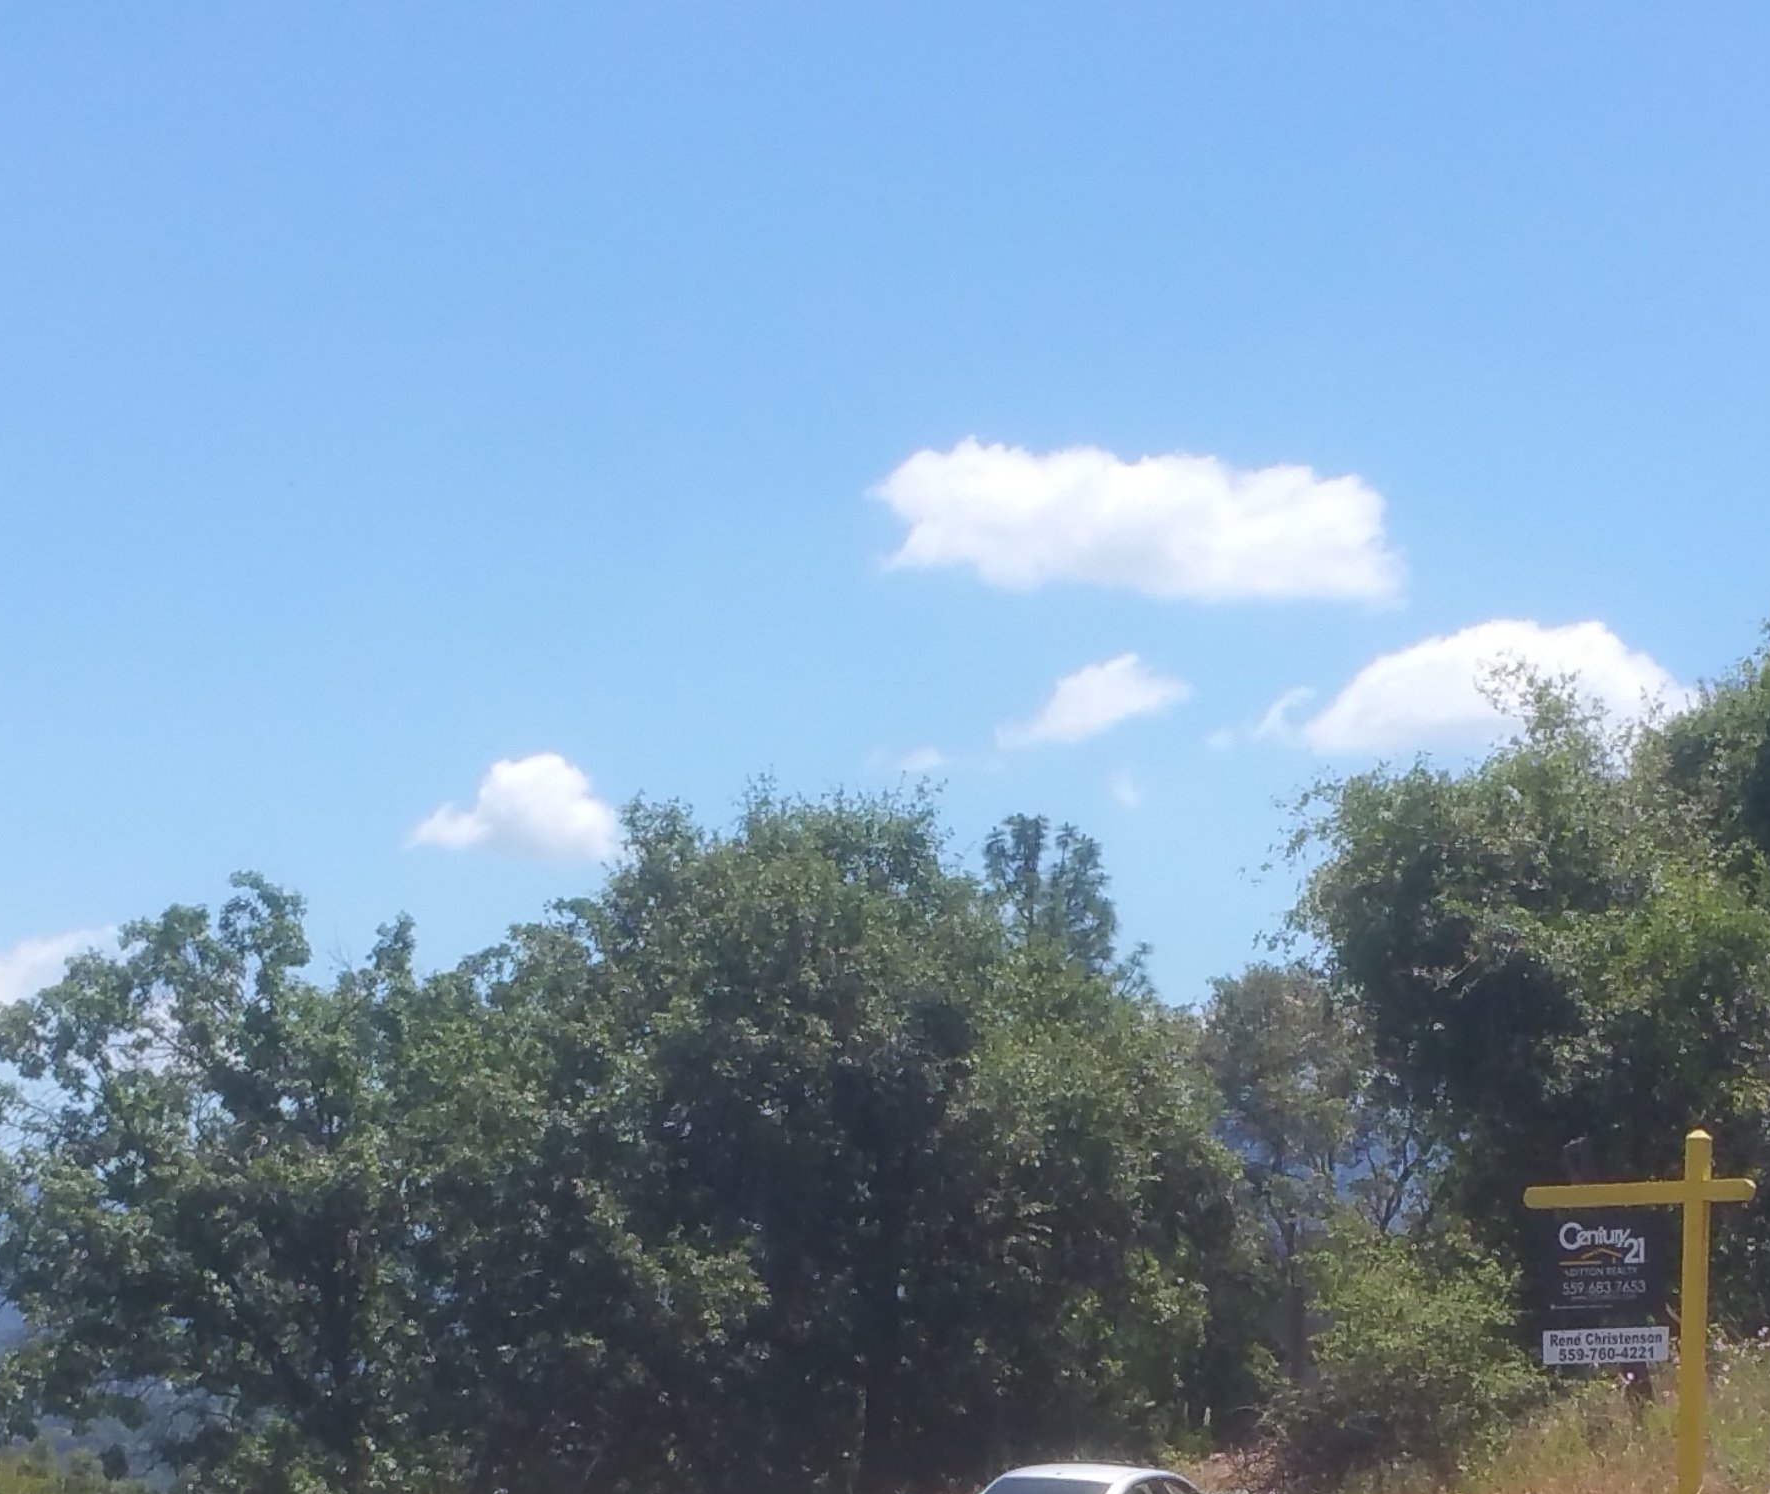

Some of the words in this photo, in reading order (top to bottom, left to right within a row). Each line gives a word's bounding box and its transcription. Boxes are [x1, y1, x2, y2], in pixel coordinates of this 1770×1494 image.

[1559, 1222, 1631, 1250] Century
[1624, 1236, 1646, 1264] 21
[1585, 1332, 1663, 1346] Christenson
